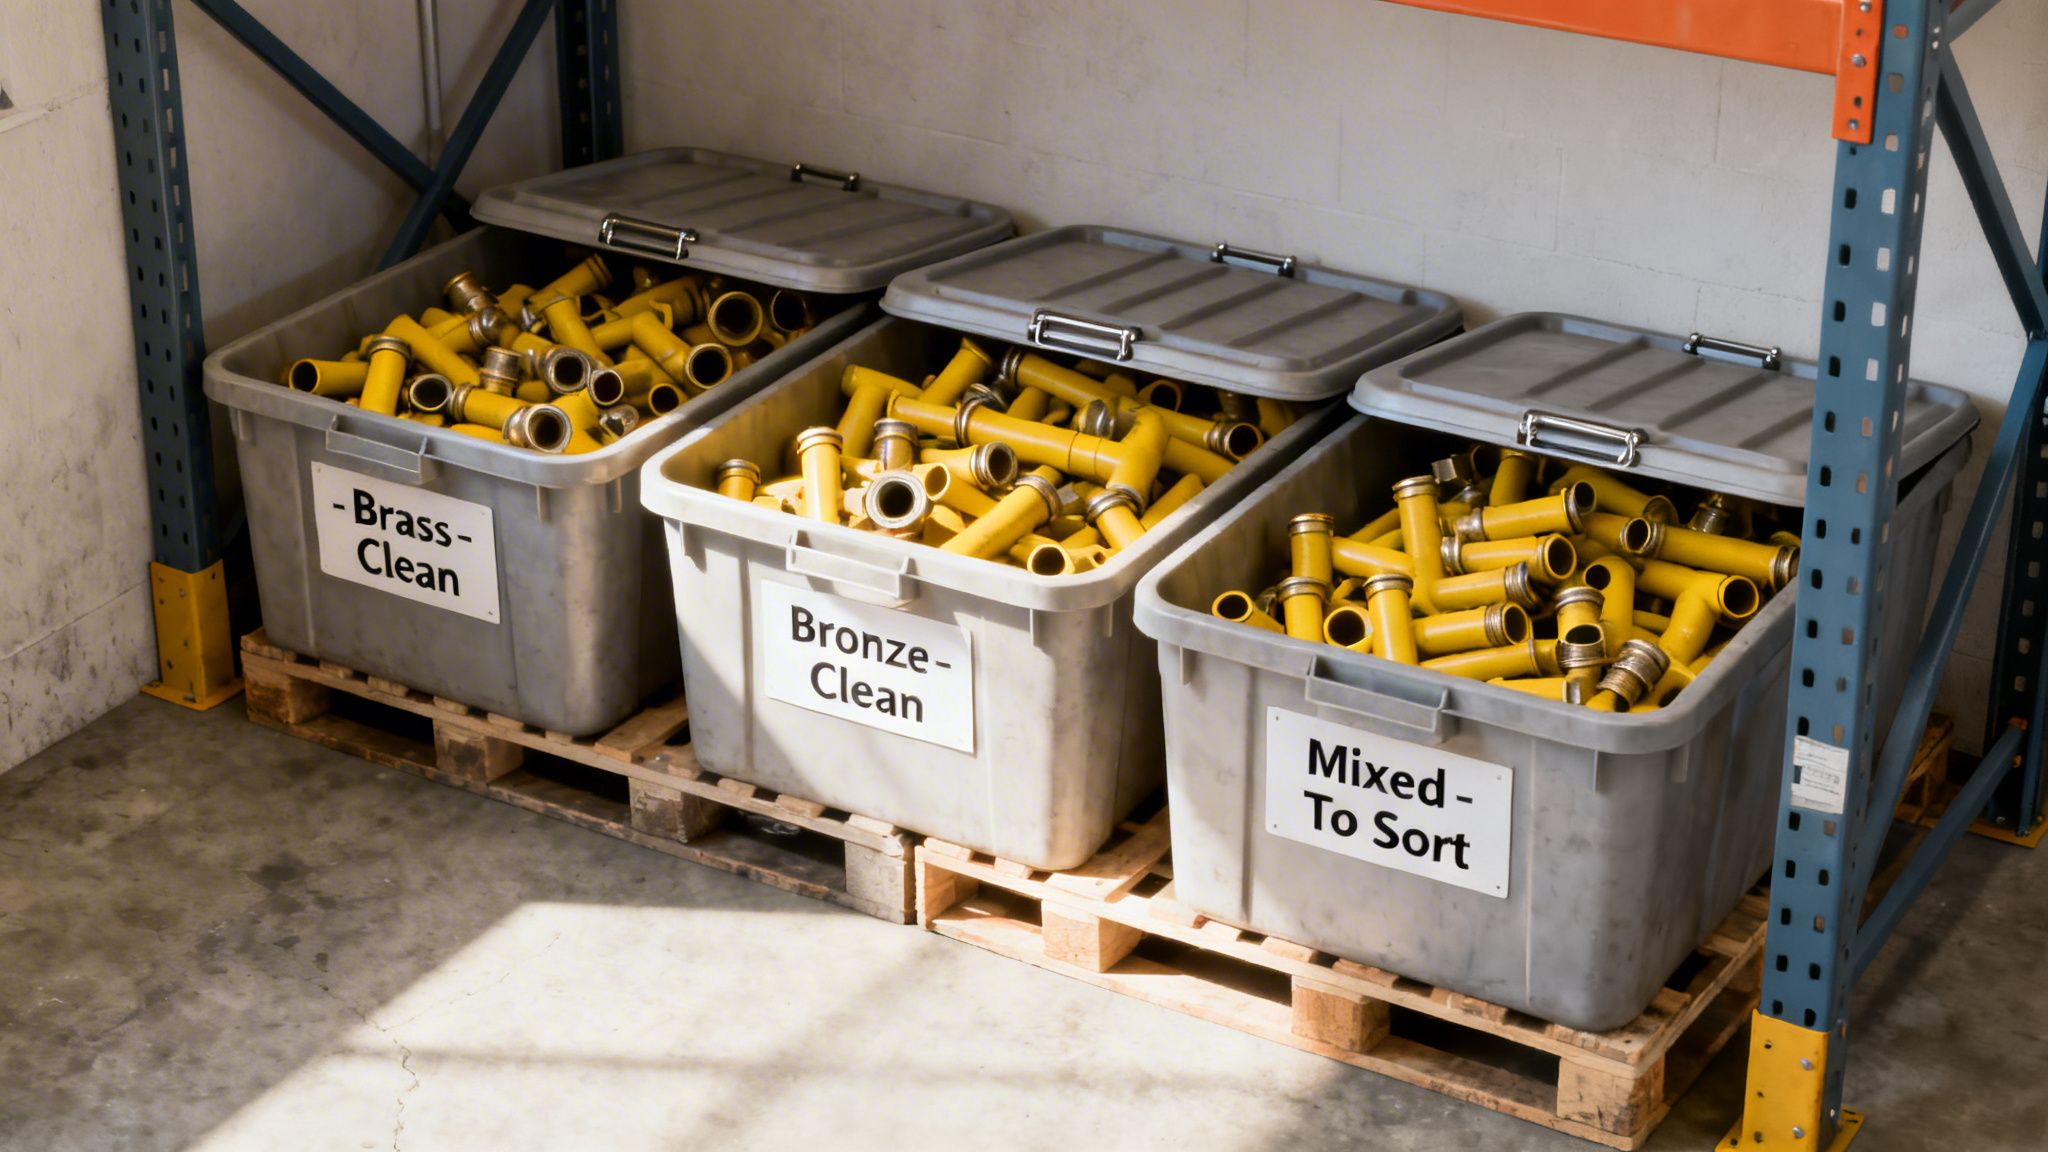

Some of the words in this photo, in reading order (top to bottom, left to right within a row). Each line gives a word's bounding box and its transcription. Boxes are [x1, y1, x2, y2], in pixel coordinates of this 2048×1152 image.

[357, 538, 460, 597] Clean
[810, 662, 923, 723] Clean
[1304, 790, 1358, 837] To
[1373, 810, 1470, 870] Sort
